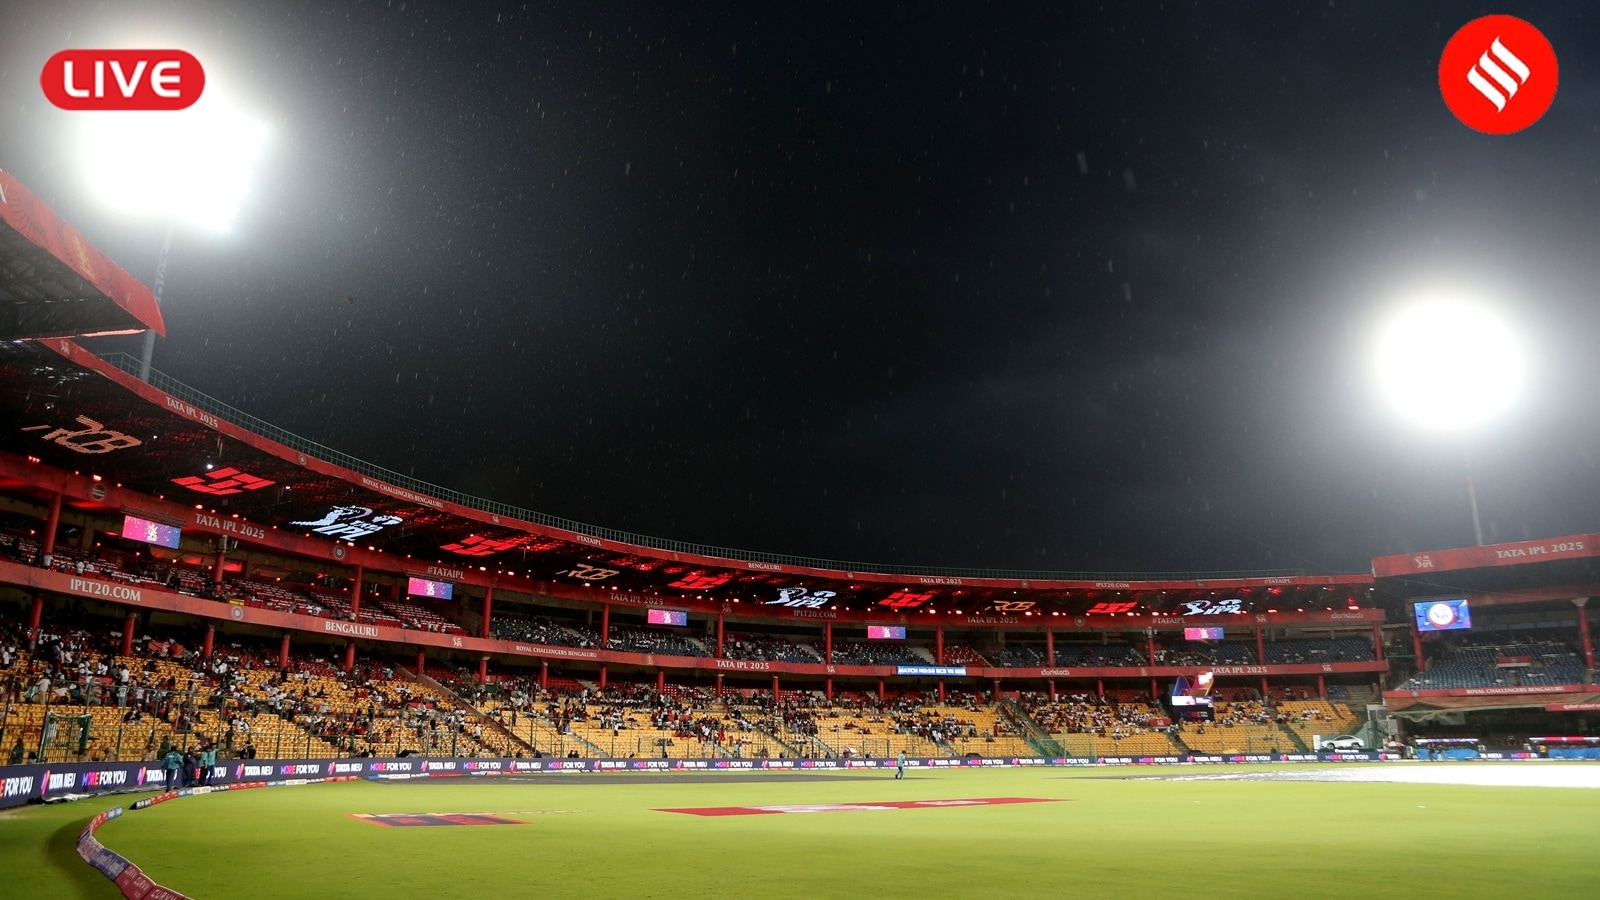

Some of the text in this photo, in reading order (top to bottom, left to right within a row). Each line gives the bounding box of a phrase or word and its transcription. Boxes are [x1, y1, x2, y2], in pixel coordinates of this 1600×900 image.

[165, 397, 219, 428] TATA IPL 2025
[362, 478, 444, 508] ROYAL CHALLENGERS BENGALURU
[195, 513, 265, 539] TATA IPL 2025
[1496, 542, 1584, 559] TATA IPL 2025
[427, 565, 465, 580] #TATAIPL
[748, 563, 782, 571] BENGALURU
[70, 578, 141, 602] IPLT20.COM
[610, 592, 664, 605] TATA IPL 2025
[993, 600, 1036, 611] RCB
[794, 610, 837, 619] IPLT20.COM
[986, 616, 998, 624] IPL
[325, 621, 378, 637] BENGALURU
[532, 647, 568, 656] CHALLENGERS
[568, 650, 597, 658] BENGALURU
[716, 660, 770, 670] TATA IPL 2025
[244, 766, 273, 776] TATA NEU
[280, 764, 320, 774] MORE FOR YOU
[336, 763, 362, 773] TATA NEU
[370, 762, 412, 771] MORE FOR YOU
[428, 762, 444, 770] TATA
[464, 762, 478, 770] MORE
[214, 766, 226, 778] YOU
[49, 773, 76, 789] TATA NEU
[82, 770, 127, 787] MORE FOR YOU
[4, 777, 20, 798] FOR
[19, 776, 34, 795] YOU
